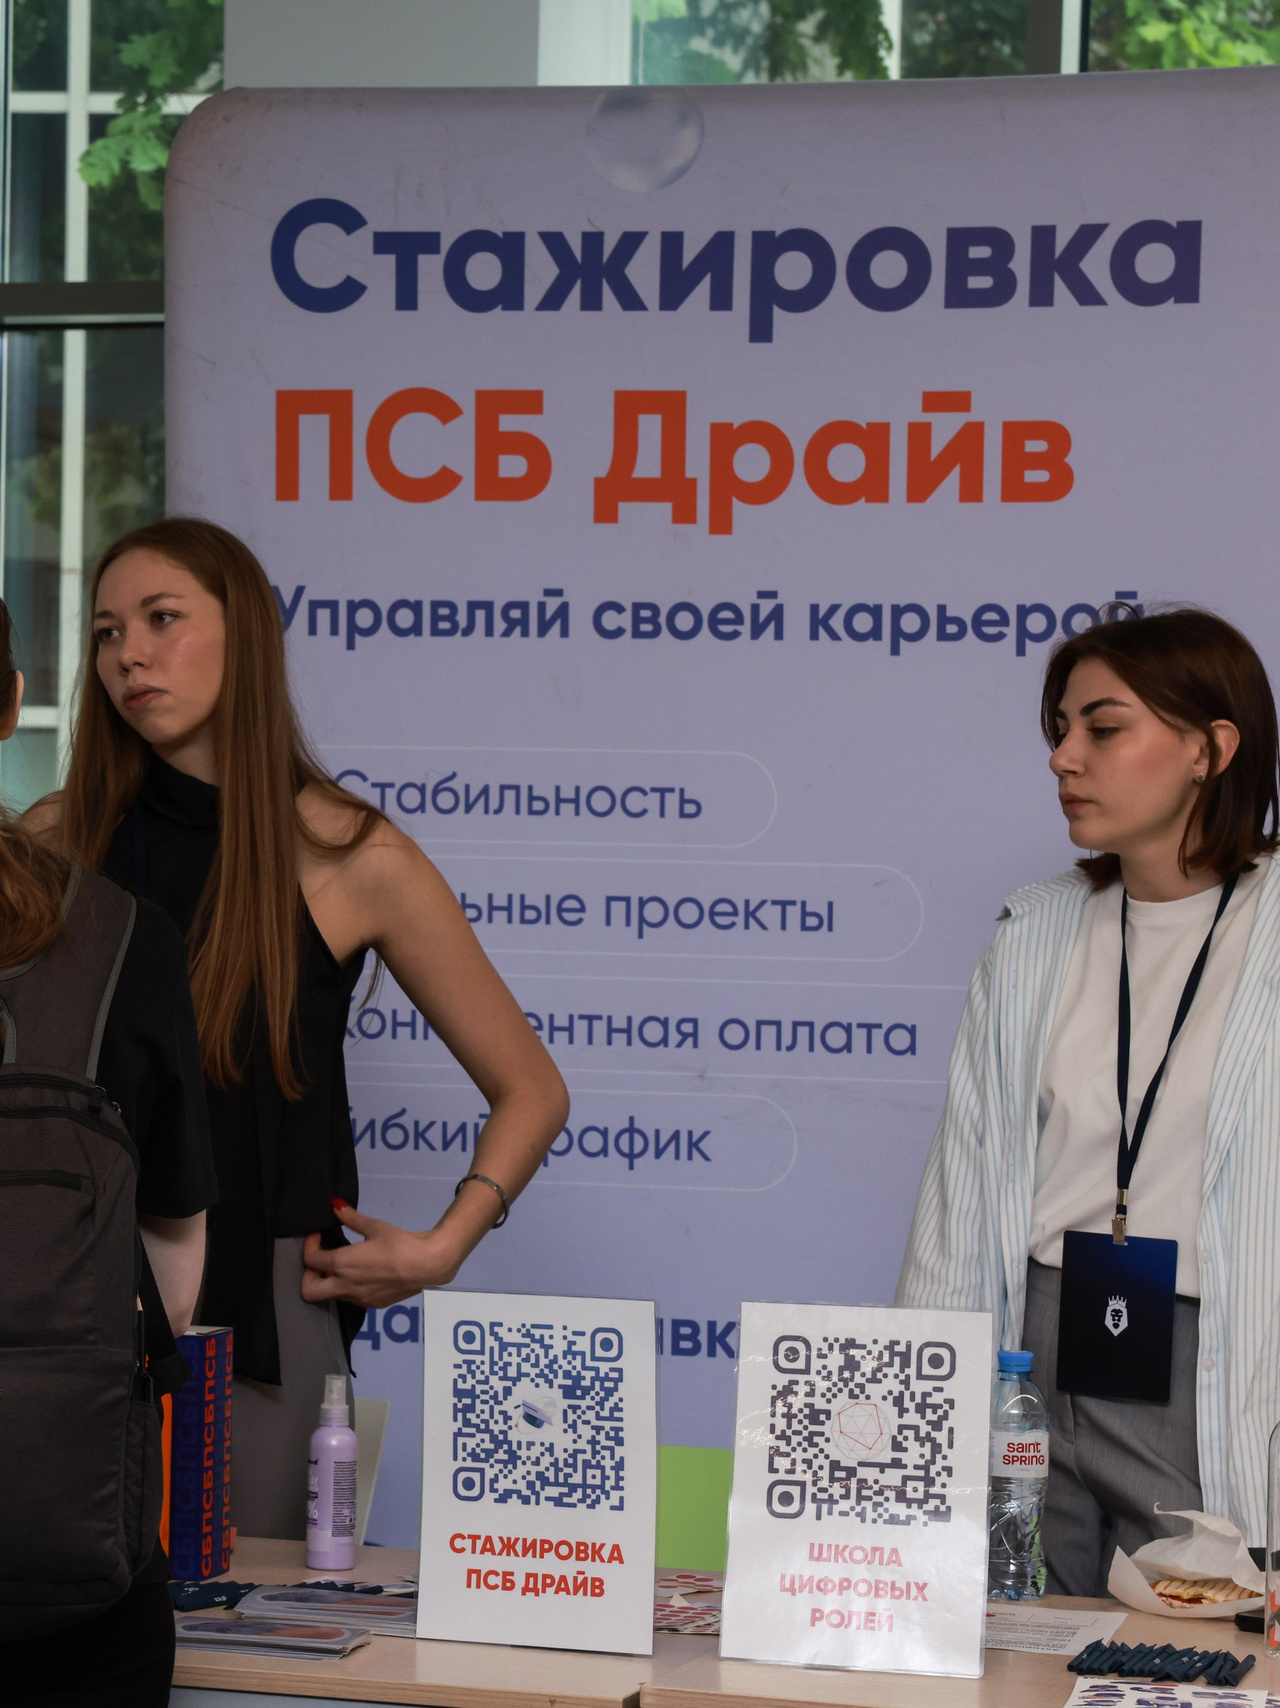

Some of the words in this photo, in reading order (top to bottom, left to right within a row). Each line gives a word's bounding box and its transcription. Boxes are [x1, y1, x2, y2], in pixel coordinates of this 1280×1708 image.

[270, 197, 1202, 344] Стажировка
[275, 387, 553, 504] ПСБ
[593, 390, 1075, 536] Драйв
[271, 585, 570, 651] Управляй
[592, 590, 784, 642] своей
[605, 894, 835, 941] проекты
[718, 1018, 917, 1056] оплата
[349, 1105, 489, 1153] ибки
[542, 1116, 712, 1170] рафик
[449, 1532, 625, 1565] СТАЖИРОВКА
[808, 1542, 903, 1567] ШКОЛА
[466, 1568, 516, 1592] ПСБ
[521, 1570, 606, 1598] ДРАЙВ
[779, 1573, 929, 1602] ЦИФРОВЫХ
[809, 1607, 894, 1633] РОЛЕЙ
